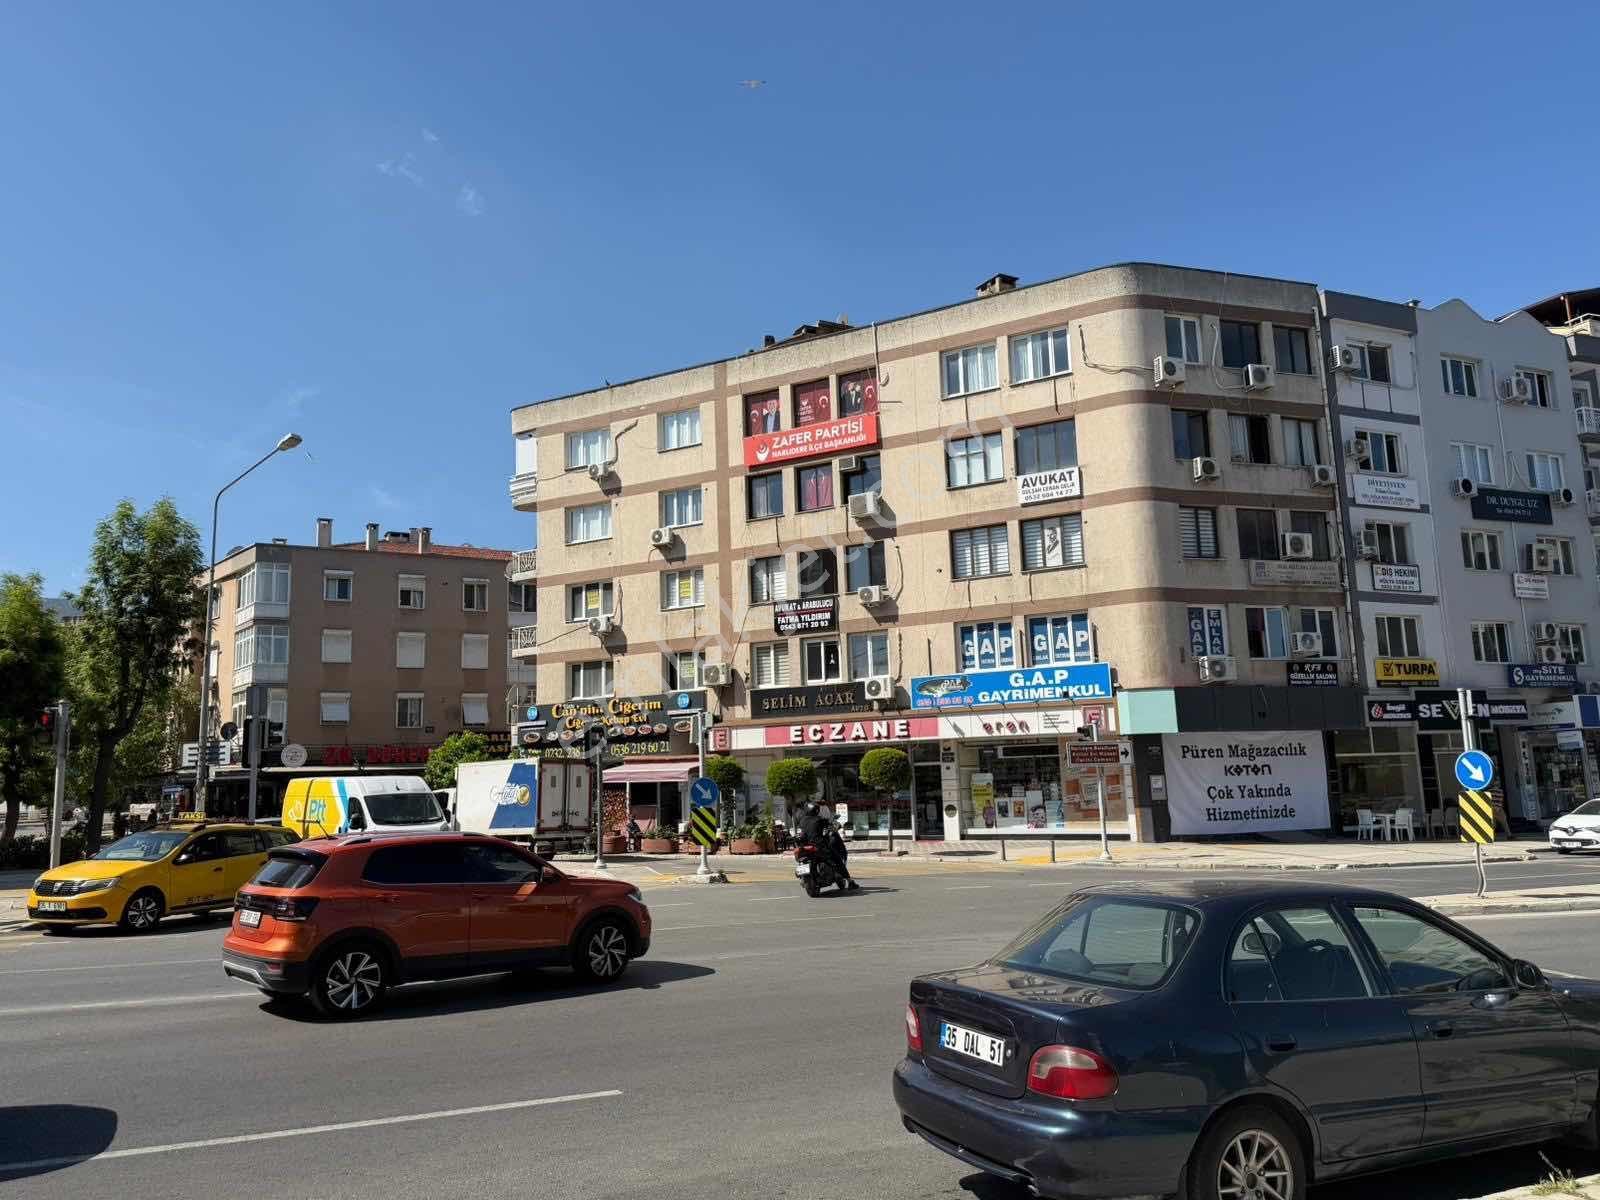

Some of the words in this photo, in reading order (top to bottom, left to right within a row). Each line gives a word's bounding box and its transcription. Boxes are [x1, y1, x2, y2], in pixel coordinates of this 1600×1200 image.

[773, 431, 812, 449] ZAFER
[815, 417, 863, 440] PARTİSİ
[1021, 470, 1075, 489] AVUKAT
[802, 600, 833, 609] ARABULUCU
[777, 616, 799, 624] FATMA
[800, 612, 831, 621] YILDIRIM
[1033, 630, 1089, 651] GAP
[1190, 619, 1204, 657] GAP
[1208, 610, 1222, 654] EMLAK
[964, 636, 1013, 656] GAP
[1009, 669, 1069, 688] G.A.P
[1394, 663, 1436, 675] TURPA
[762, 694, 807, 710] SELİM
[815, 691, 856, 707] ACAR
[789, 719, 910, 743] ECZANE
[631, 743, 647, 754] 219
[647, 741, 659, 752] 60
[1181, 743, 1224, 760] Püren
[1227, 743, 1307, 762] Mağazacılık
[1206, 784, 1235, 803] Çok
[1237, 783, 1293, 800] Yakında
[1205, 804, 1296, 822] Hizmetinizde
[945, 1026, 958, 1048] 35
[963, 1031, 981, 1056] DAL
[989, 1039, 1002, 1064] 51
